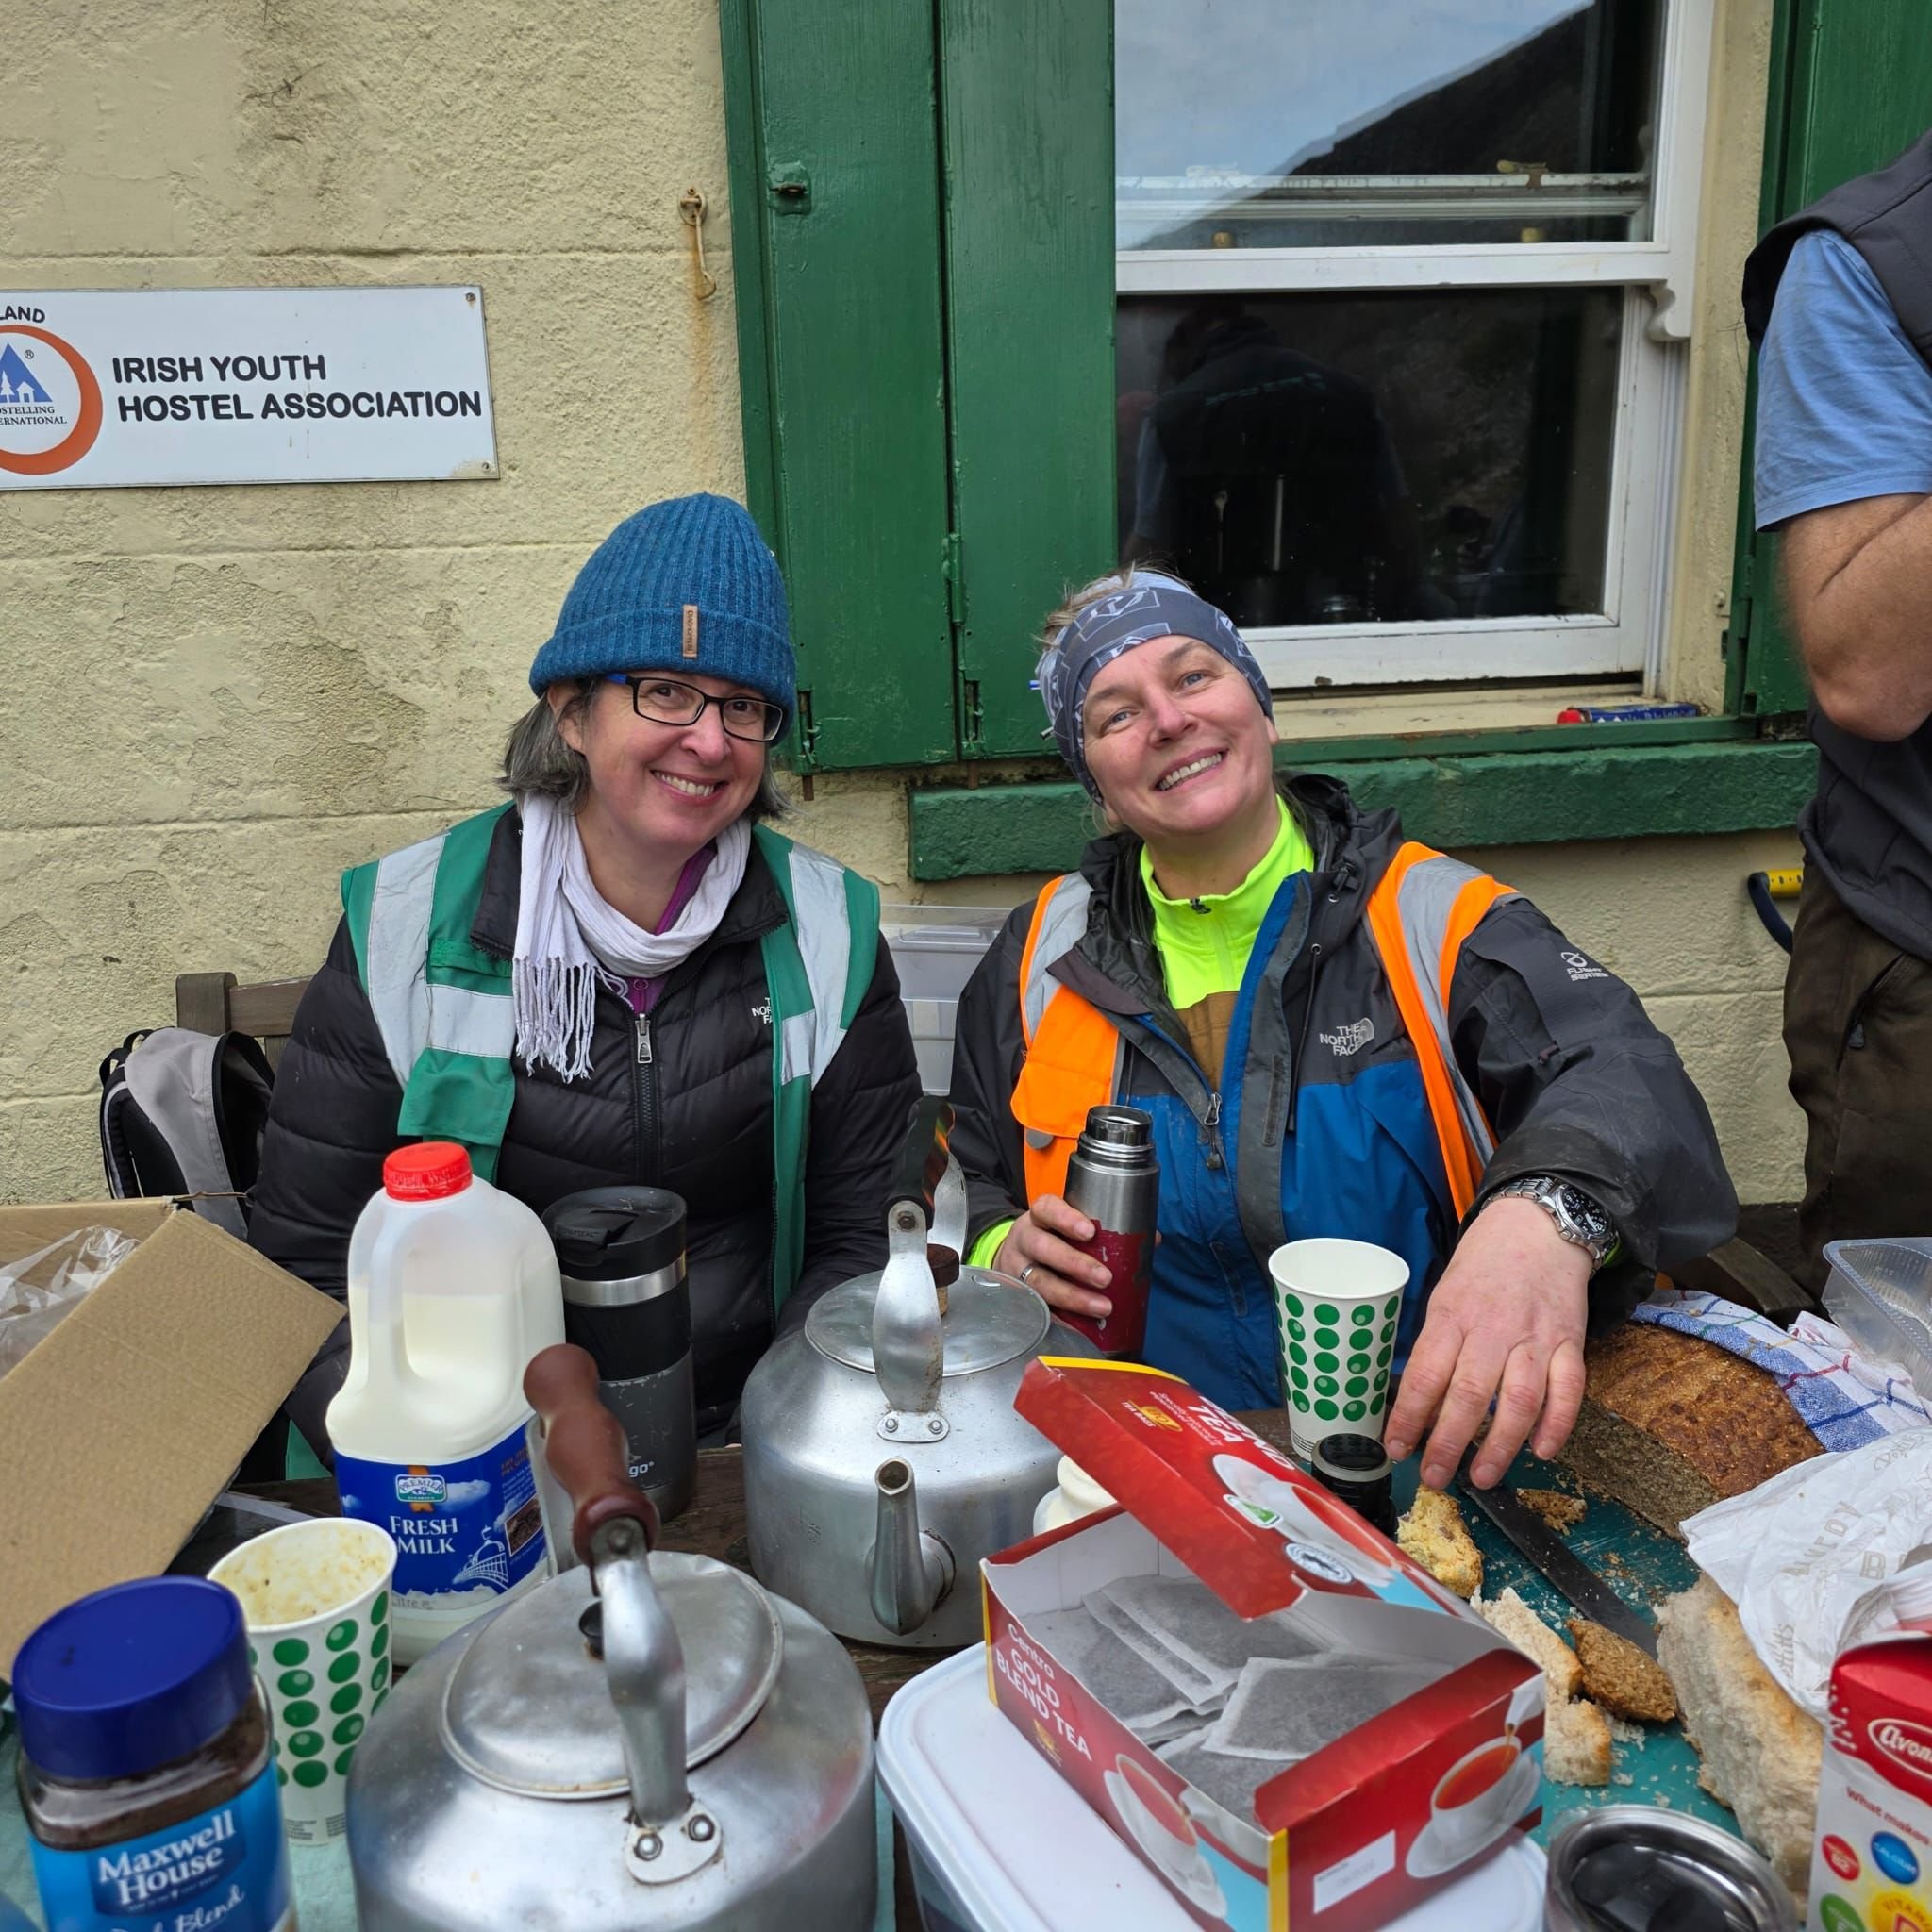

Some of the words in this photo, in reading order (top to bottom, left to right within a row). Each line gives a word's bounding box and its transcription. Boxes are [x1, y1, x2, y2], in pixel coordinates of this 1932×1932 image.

[112, 356, 202, 384] IRISH
[209, 354, 326, 381] YOUTH
[118, 393, 253, 423] HOSTEL
[260, 391, 482, 420] ASSOCIATION
[1319, 1033, 1359, 1046] NORTH
[1336, 1022, 1360, 1036] THE
[1333, 1042, 1359, 1056] FACE
[1188, 1405, 1245, 1442] TEA
[390, 1515, 458, 1536] FRESH
[398, 1536, 456, 1555] MILK
[1008, 1623, 1055, 1680] Centra
[1010, 1648, 1060, 1708] GOLD
[995, 1648, 1050, 1720] BLEND
[1052, 1710, 1092, 1761] TEA
[98, 1808, 237, 1883] Maxwell
[119, 1846, 225, 1906] House
